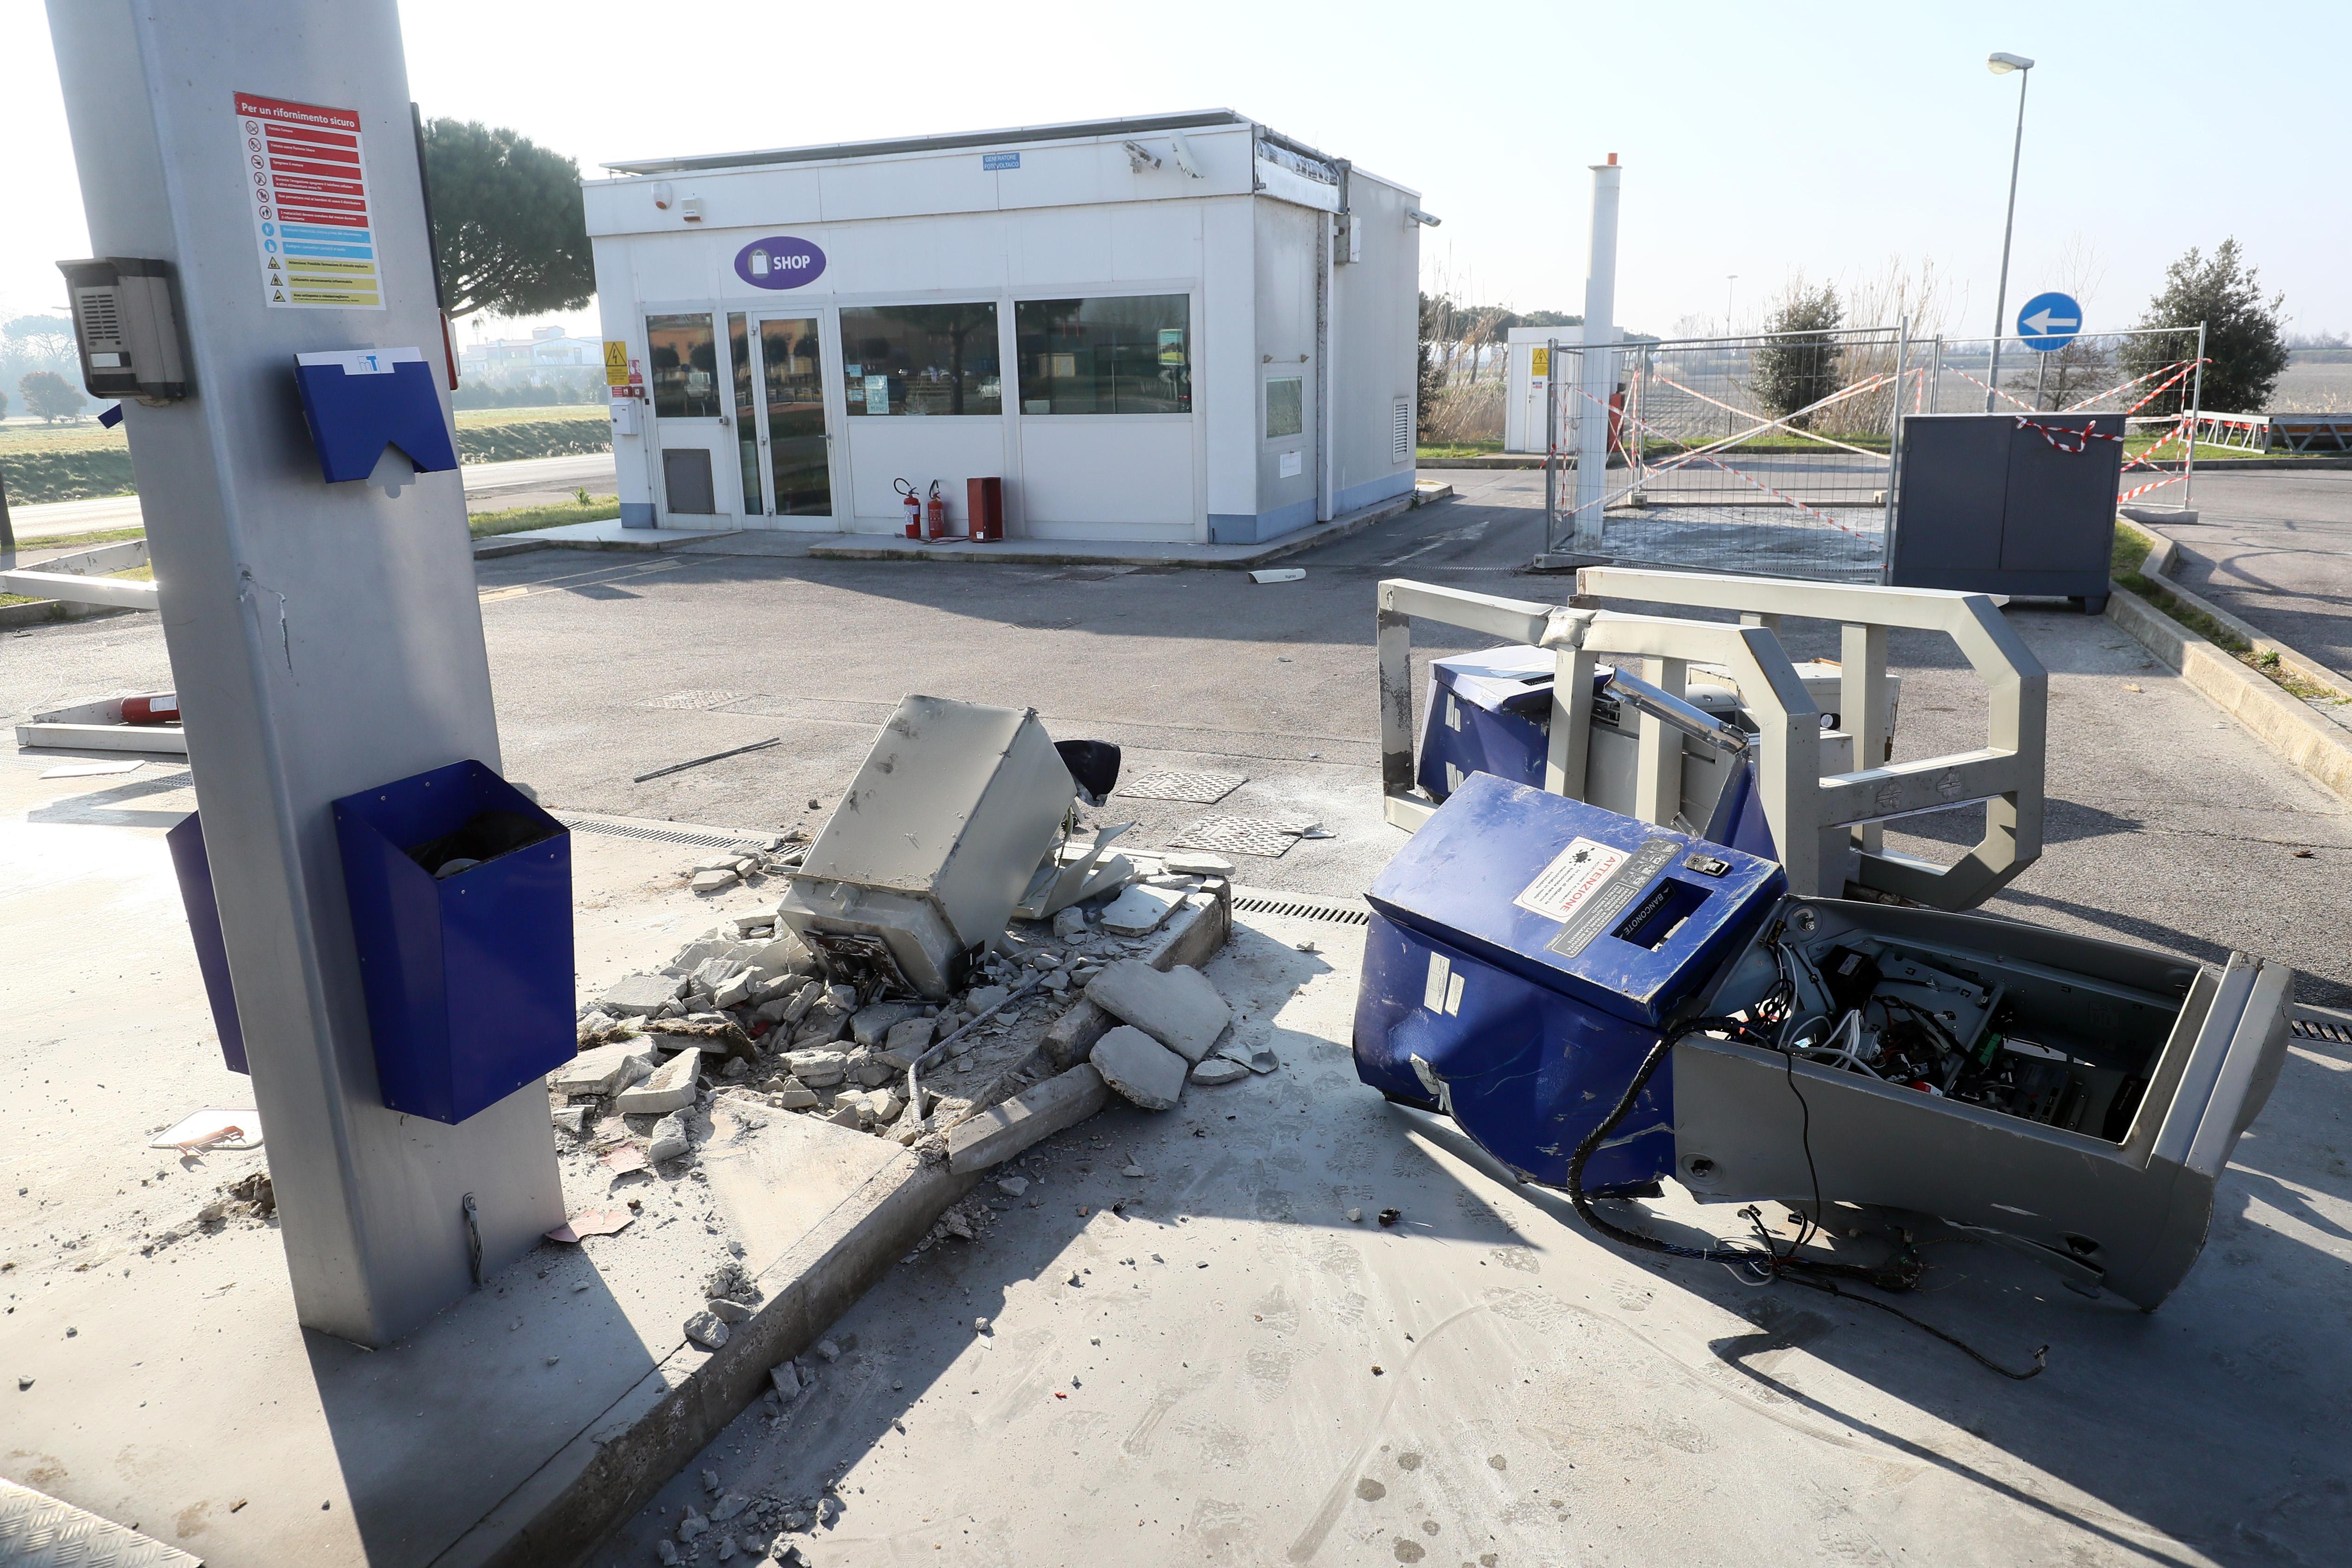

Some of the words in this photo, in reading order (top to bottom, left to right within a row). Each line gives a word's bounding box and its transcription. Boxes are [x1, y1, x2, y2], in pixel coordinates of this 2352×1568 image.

[242, 103, 257, 113] Per
[259, 105, 271, 115] un
[273, 107, 328, 124] rifornimento
[329, 116, 355, 128] sicuro
[773, 255, 811, 270] SHOP
[1547, 866, 1566, 884] macchiate
[1553, 867, 1572, 886] banconote
[1566, 873, 1575, 882] caso
[1579, 859, 1602, 882] L'ACCETTATORE
[1536, 872, 1553, 888] indelebile
[1560, 857, 1616, 912] ATTENZIONE
[1533, 889, 1544, 899] modo
[1539, 887, 1554, 901] saranno
[1548, 887, 1562, 900] attacco
[1559, 886, 1577, 903] ALLARMATO
[1607, 885, 1620, 897] ENTRO
[1591, 900, 1605, 913] MINUTI
[1623, 893, 1664, 936] BANCONOTE
[1568, 908, 1603, 943] AUTOMATICAMENTE
[1590, 912, 1606, 927] RITIRARE
[1596, 909, 1615, 927] MANCATA
[1567, 933, 1585, 950] RICEVUTA
[1570, 931, 1593, 953] INCOMPLETA
